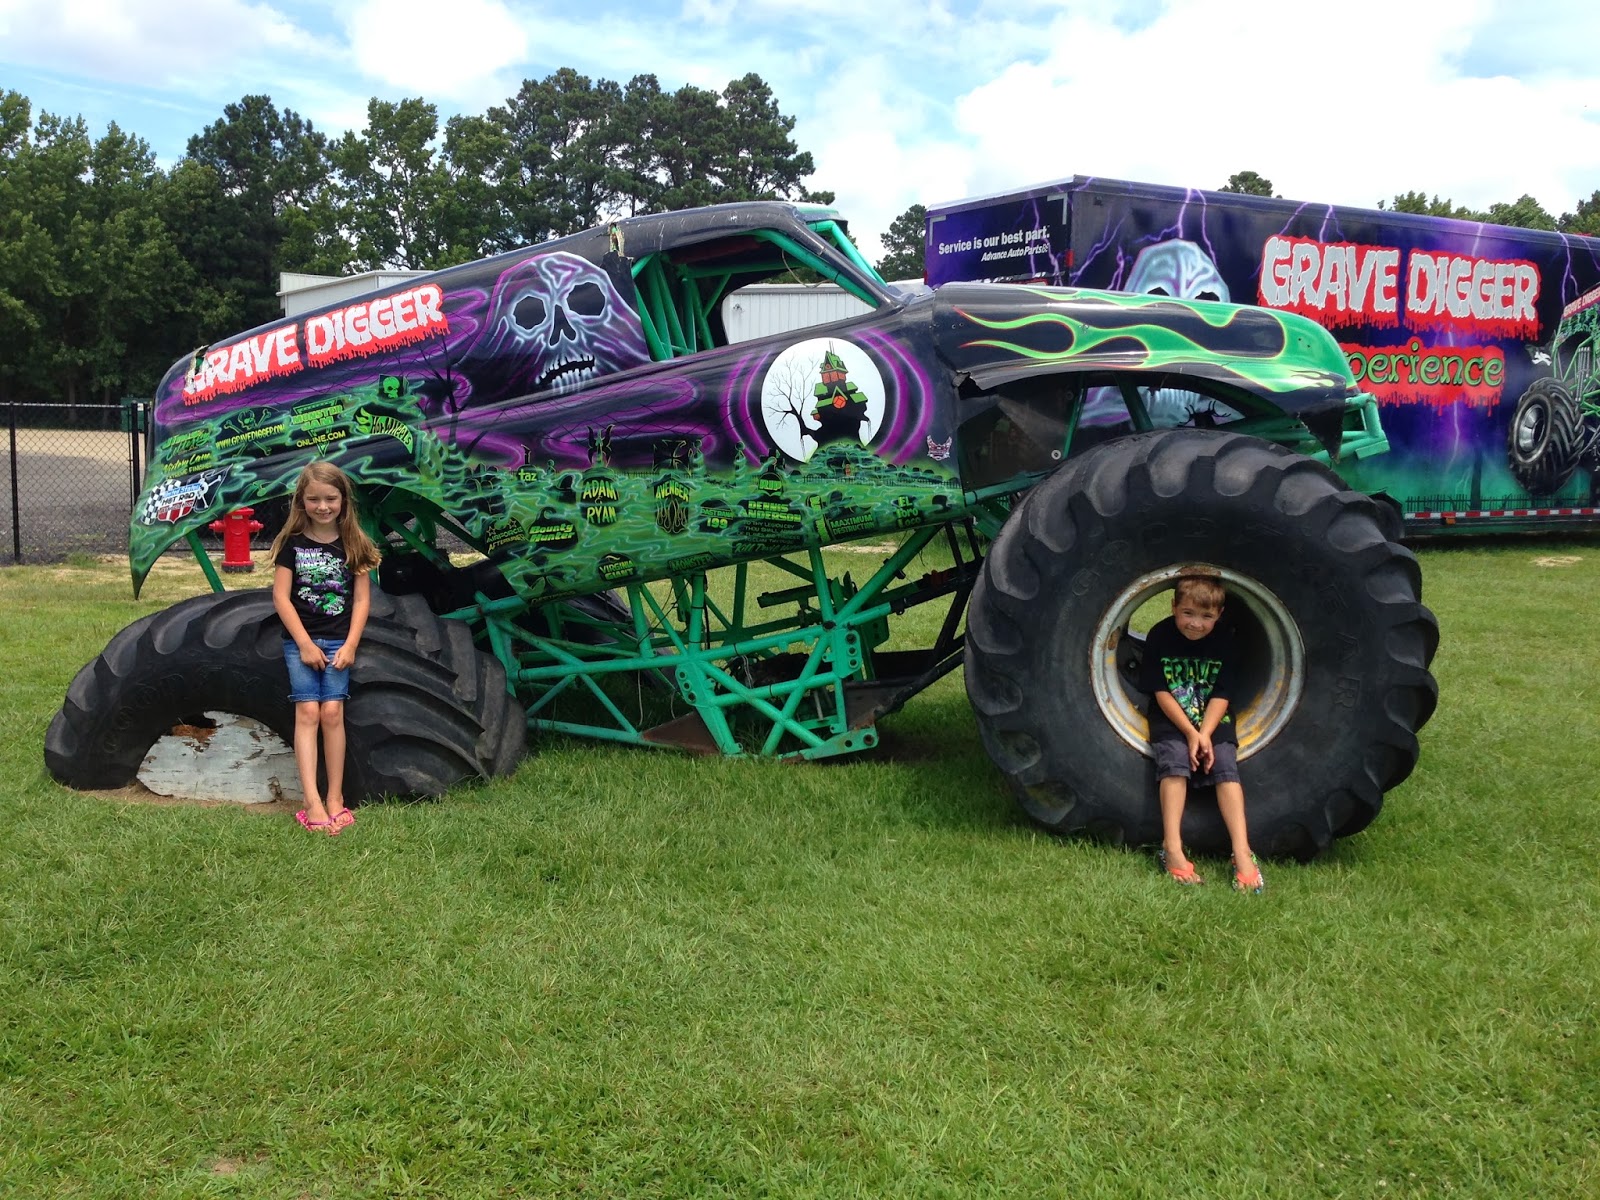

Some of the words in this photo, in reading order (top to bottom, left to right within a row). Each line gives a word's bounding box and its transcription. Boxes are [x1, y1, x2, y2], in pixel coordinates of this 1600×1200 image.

[938, 240, 972, 255] Service
[973, 237, 982, 249] is
[983, 236, 999, 247] our
[1001, 229, 1023, 245] best
[1025, 226, 1050, 244] part.
[981, 250, 1008, 262] Advance
[1007, 247, 1024, 258] Auto
[1024, 245, 1042, 256] Parts
[1260, 236, 1399, 313] GRAVE
[1407, 252, 1539, 321] DIGGER
[307, 286, 444, 355] DIGGER
[293, 405, 344, 424] MONSTER
[302, 416, 335, 431] JAM
[296, 430, 346, 448] ONLINE.COM
[518, 468, 537, 481] taz
[179, 491, 195, 501] ROD
[582, 480, 617, 500] ADAM
[656, 480, 689, 502] AVENGER
[748, 501, 789, 512] DENNIS
[898, 496, 912, 507] EL
[587, 505, 617, 523] RYAN
[738, 509, 802, 522] ANDERSON
[830, 514, 873, 528] MAXIMUM
[529, 523, 574, 535] Bounty
[706, 517, 728, 529] 199
[529, 531, 576, 543] Hunter
[599, 560, 633, 574] VIRGINIA
[604, 568, 635, 580] GIANT
